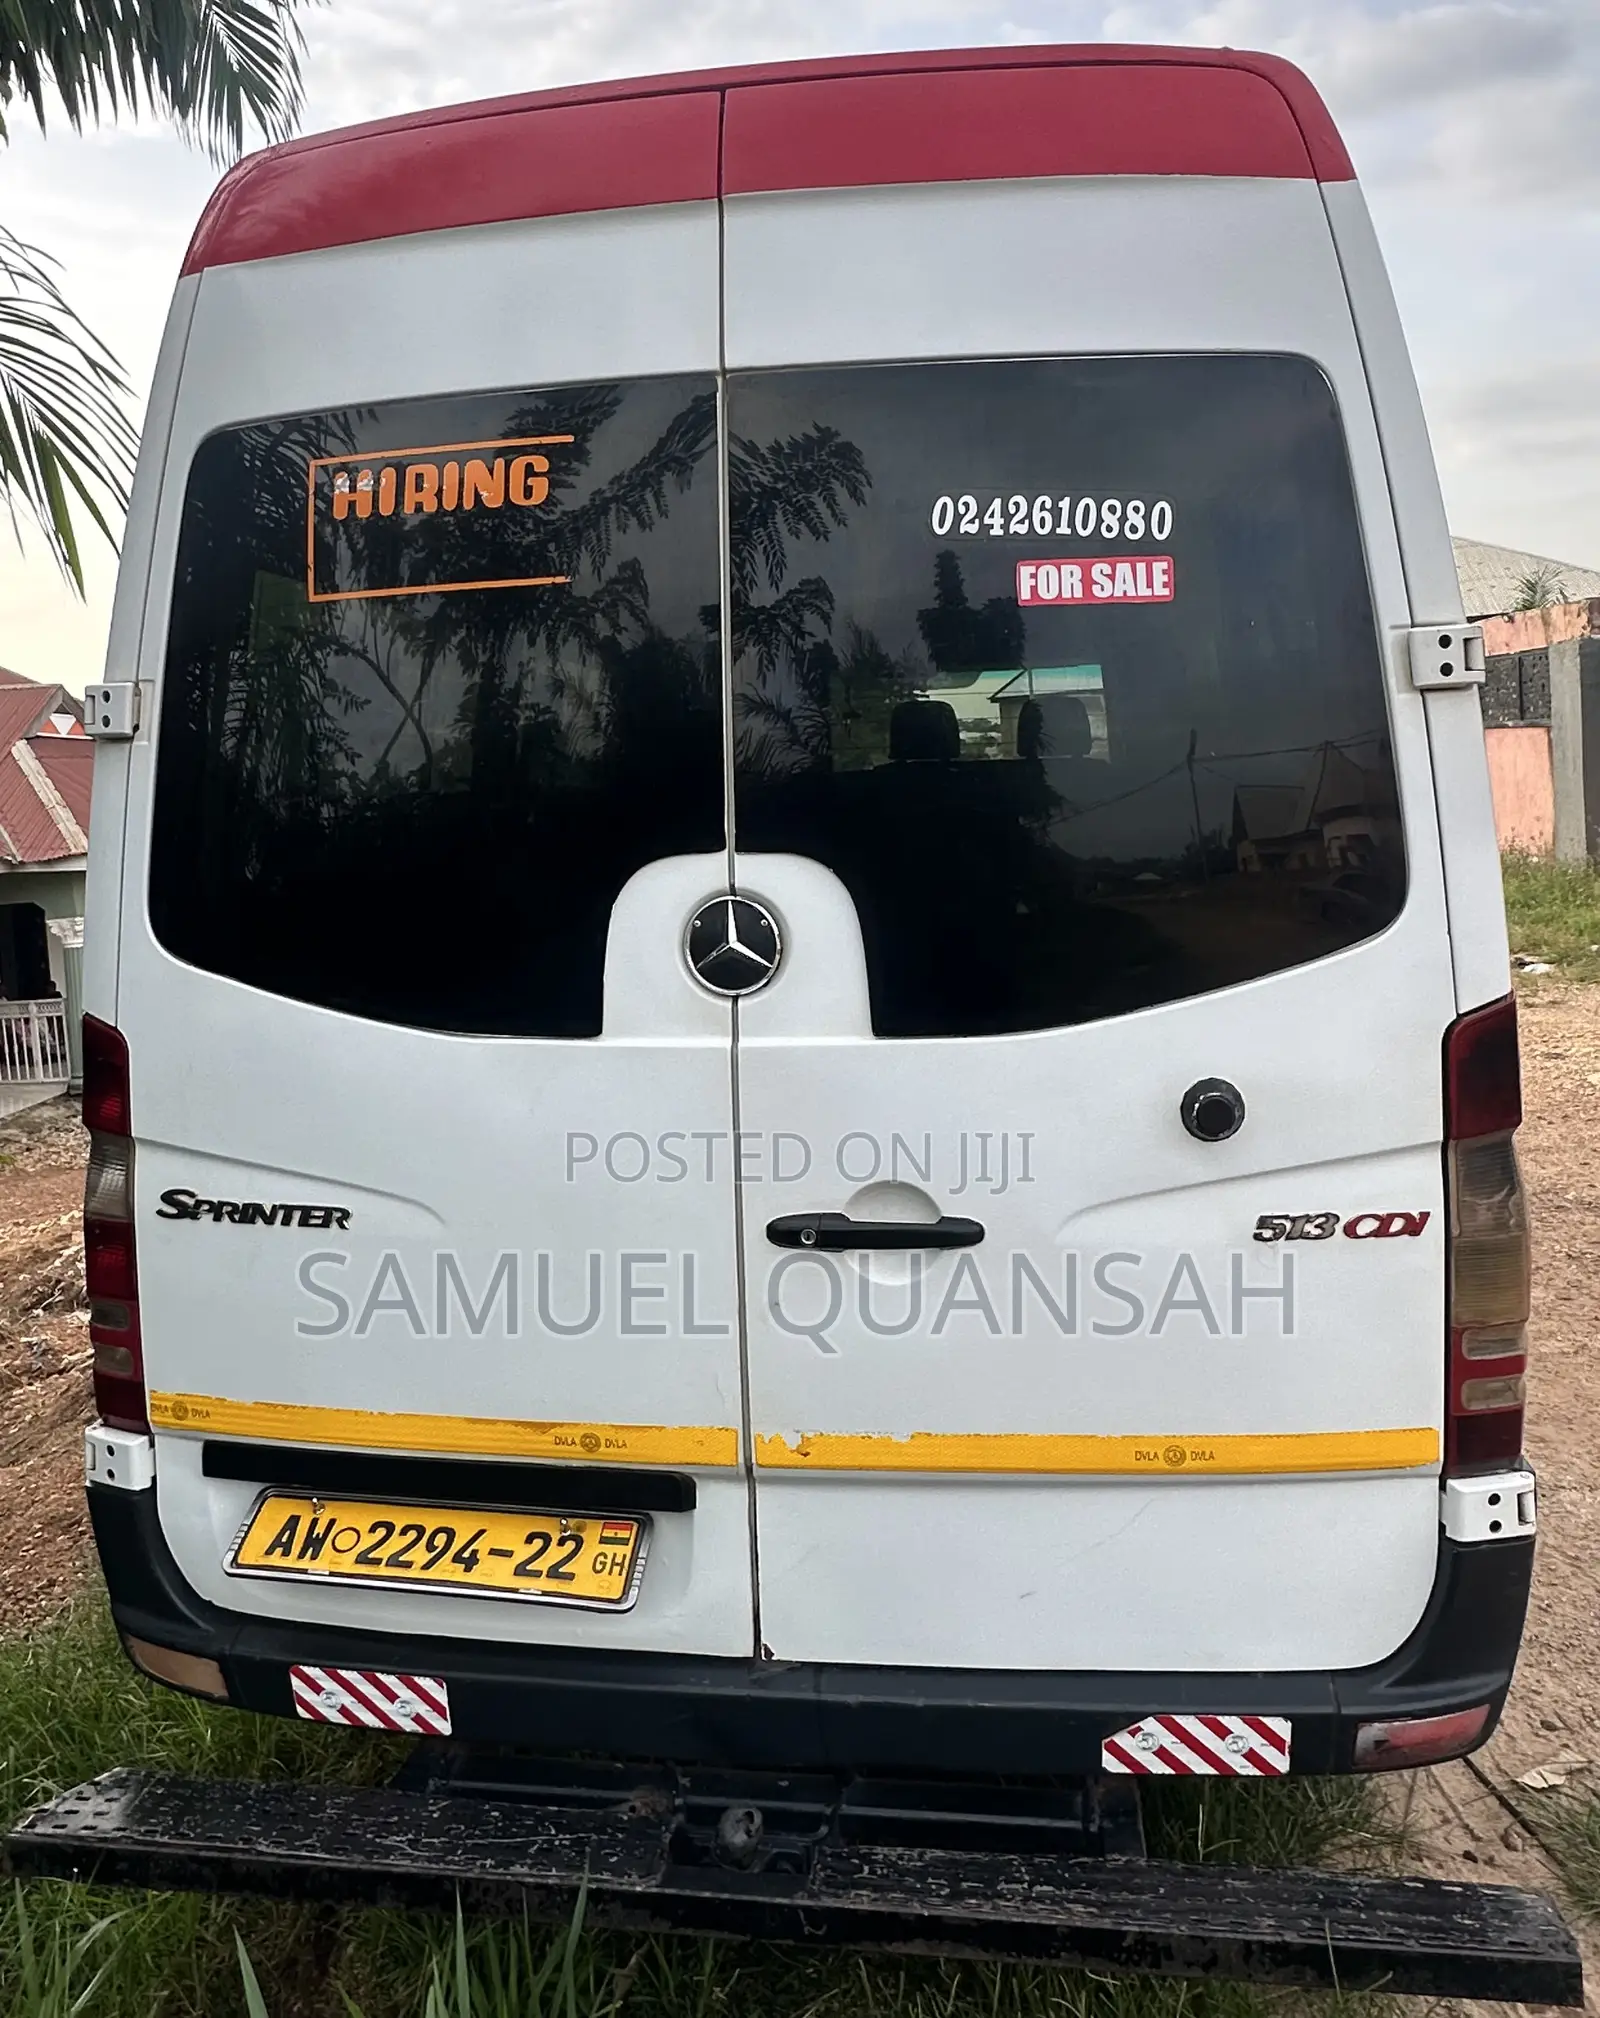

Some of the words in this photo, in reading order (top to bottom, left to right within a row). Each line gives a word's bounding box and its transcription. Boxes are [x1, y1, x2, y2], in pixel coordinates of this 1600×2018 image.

[333, 455, 549, 520] HIRING
[931, 495, 1173, 540] 0242610880
[1020, 564, 1083, 600] FOR
[1091, 562, 1170, 598] SALE
[156, 1188, 351, 1230] SPRINTER
[1253, 1212, 1340, 1242] 513
[1343, 1211, 1431, 1239] CDI
[554, 1436, 577, 1447] DVLA
[605, 1438, 628, 1448] DVLA
[1135, 1450, 1159, 1461] DVLA
[1191, 1451, 1215, 1461] DVLA
[592, 1552, 627, 1576] GH
